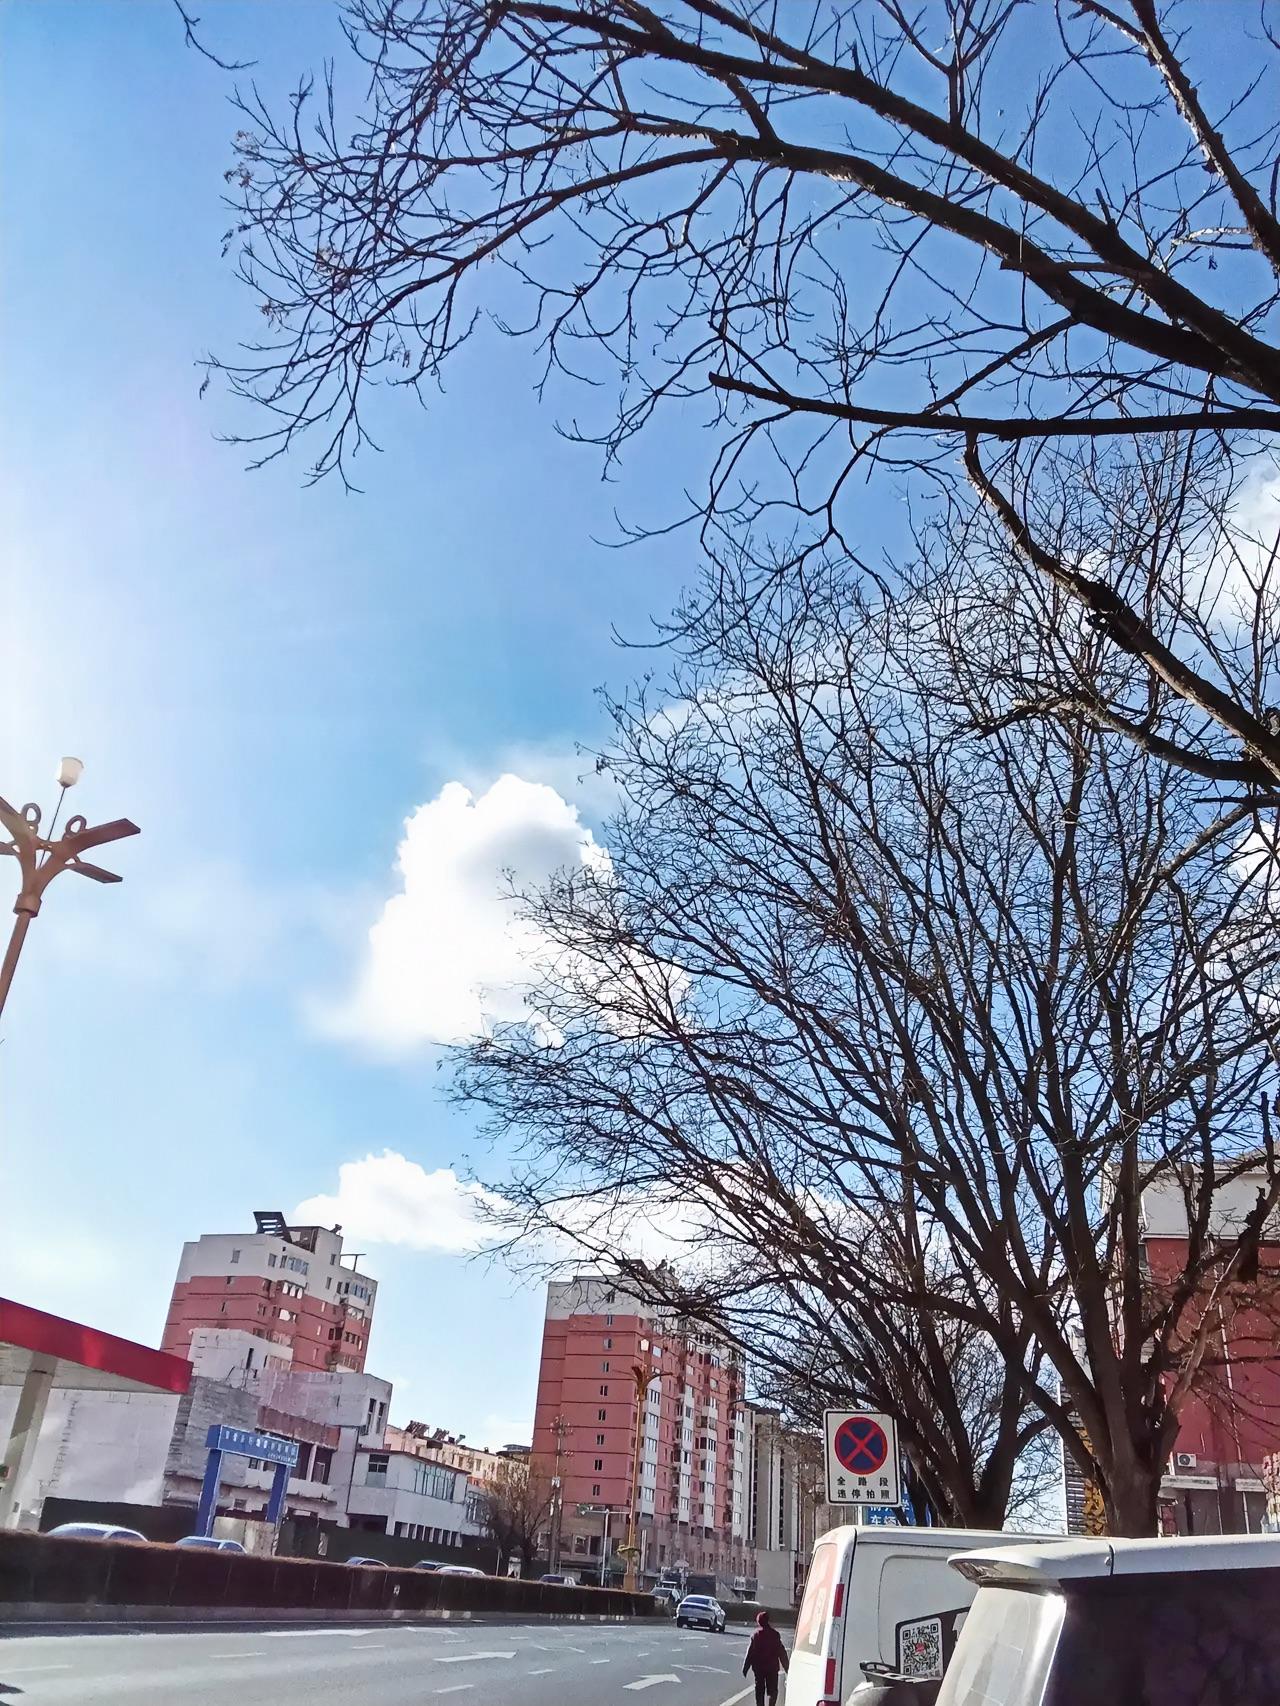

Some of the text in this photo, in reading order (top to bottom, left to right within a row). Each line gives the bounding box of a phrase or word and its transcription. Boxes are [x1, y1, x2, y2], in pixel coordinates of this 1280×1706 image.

[837, 1476, 888, 1486] 全路段
[838, 1489, 889, 1499] 违停拍照
